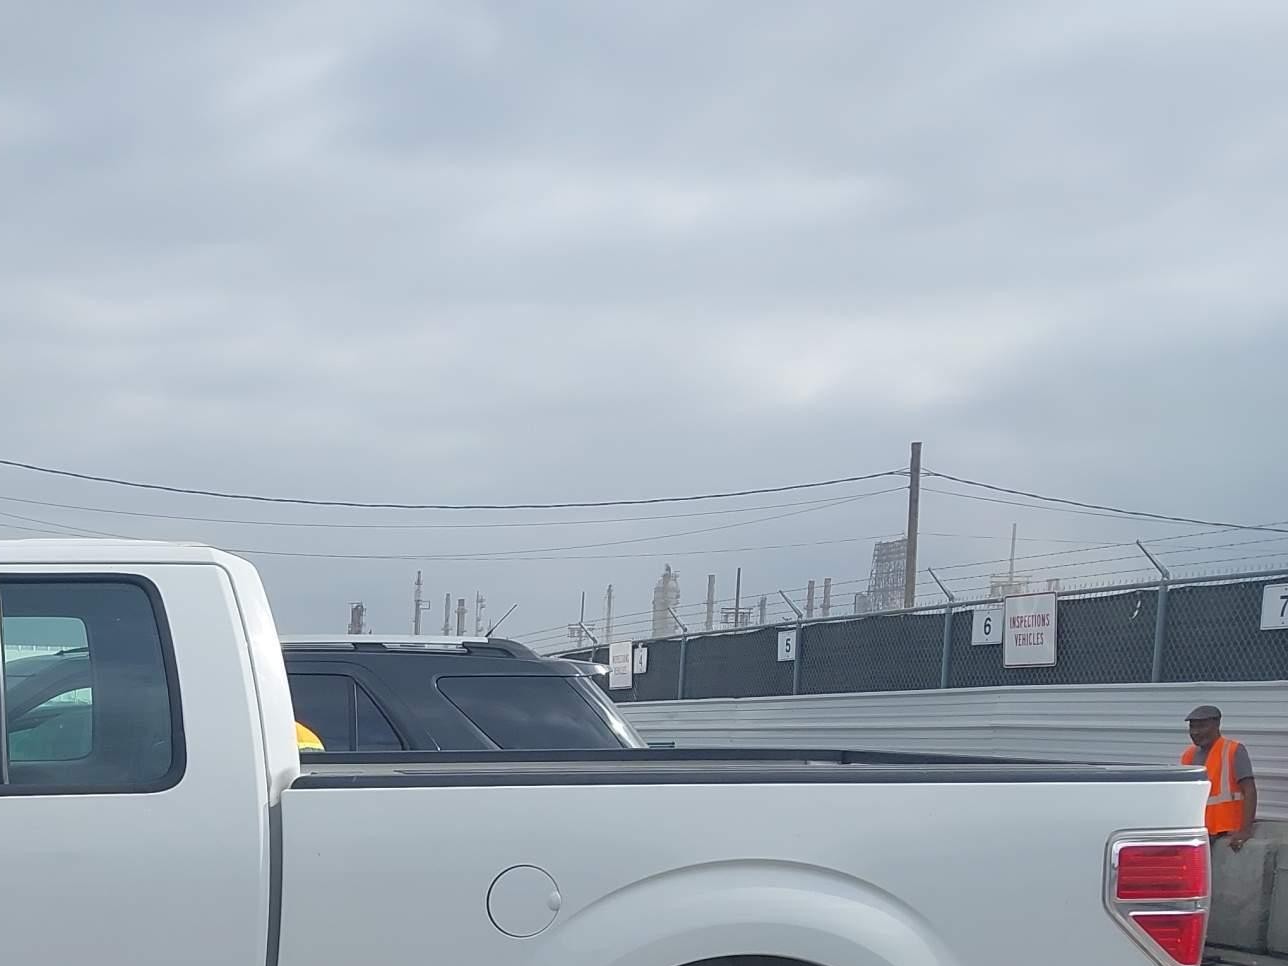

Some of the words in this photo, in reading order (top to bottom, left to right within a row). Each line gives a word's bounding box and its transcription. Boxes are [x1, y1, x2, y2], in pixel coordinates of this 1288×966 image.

[1279, 595, 1288, 618] 7
[983, 616, 992, 636] 6
[1009, 612, 1051, 629] INSPECTIONS
[785, 637, 791, 653] 5
[1014, 632, 1044, 647] VEHICLES
